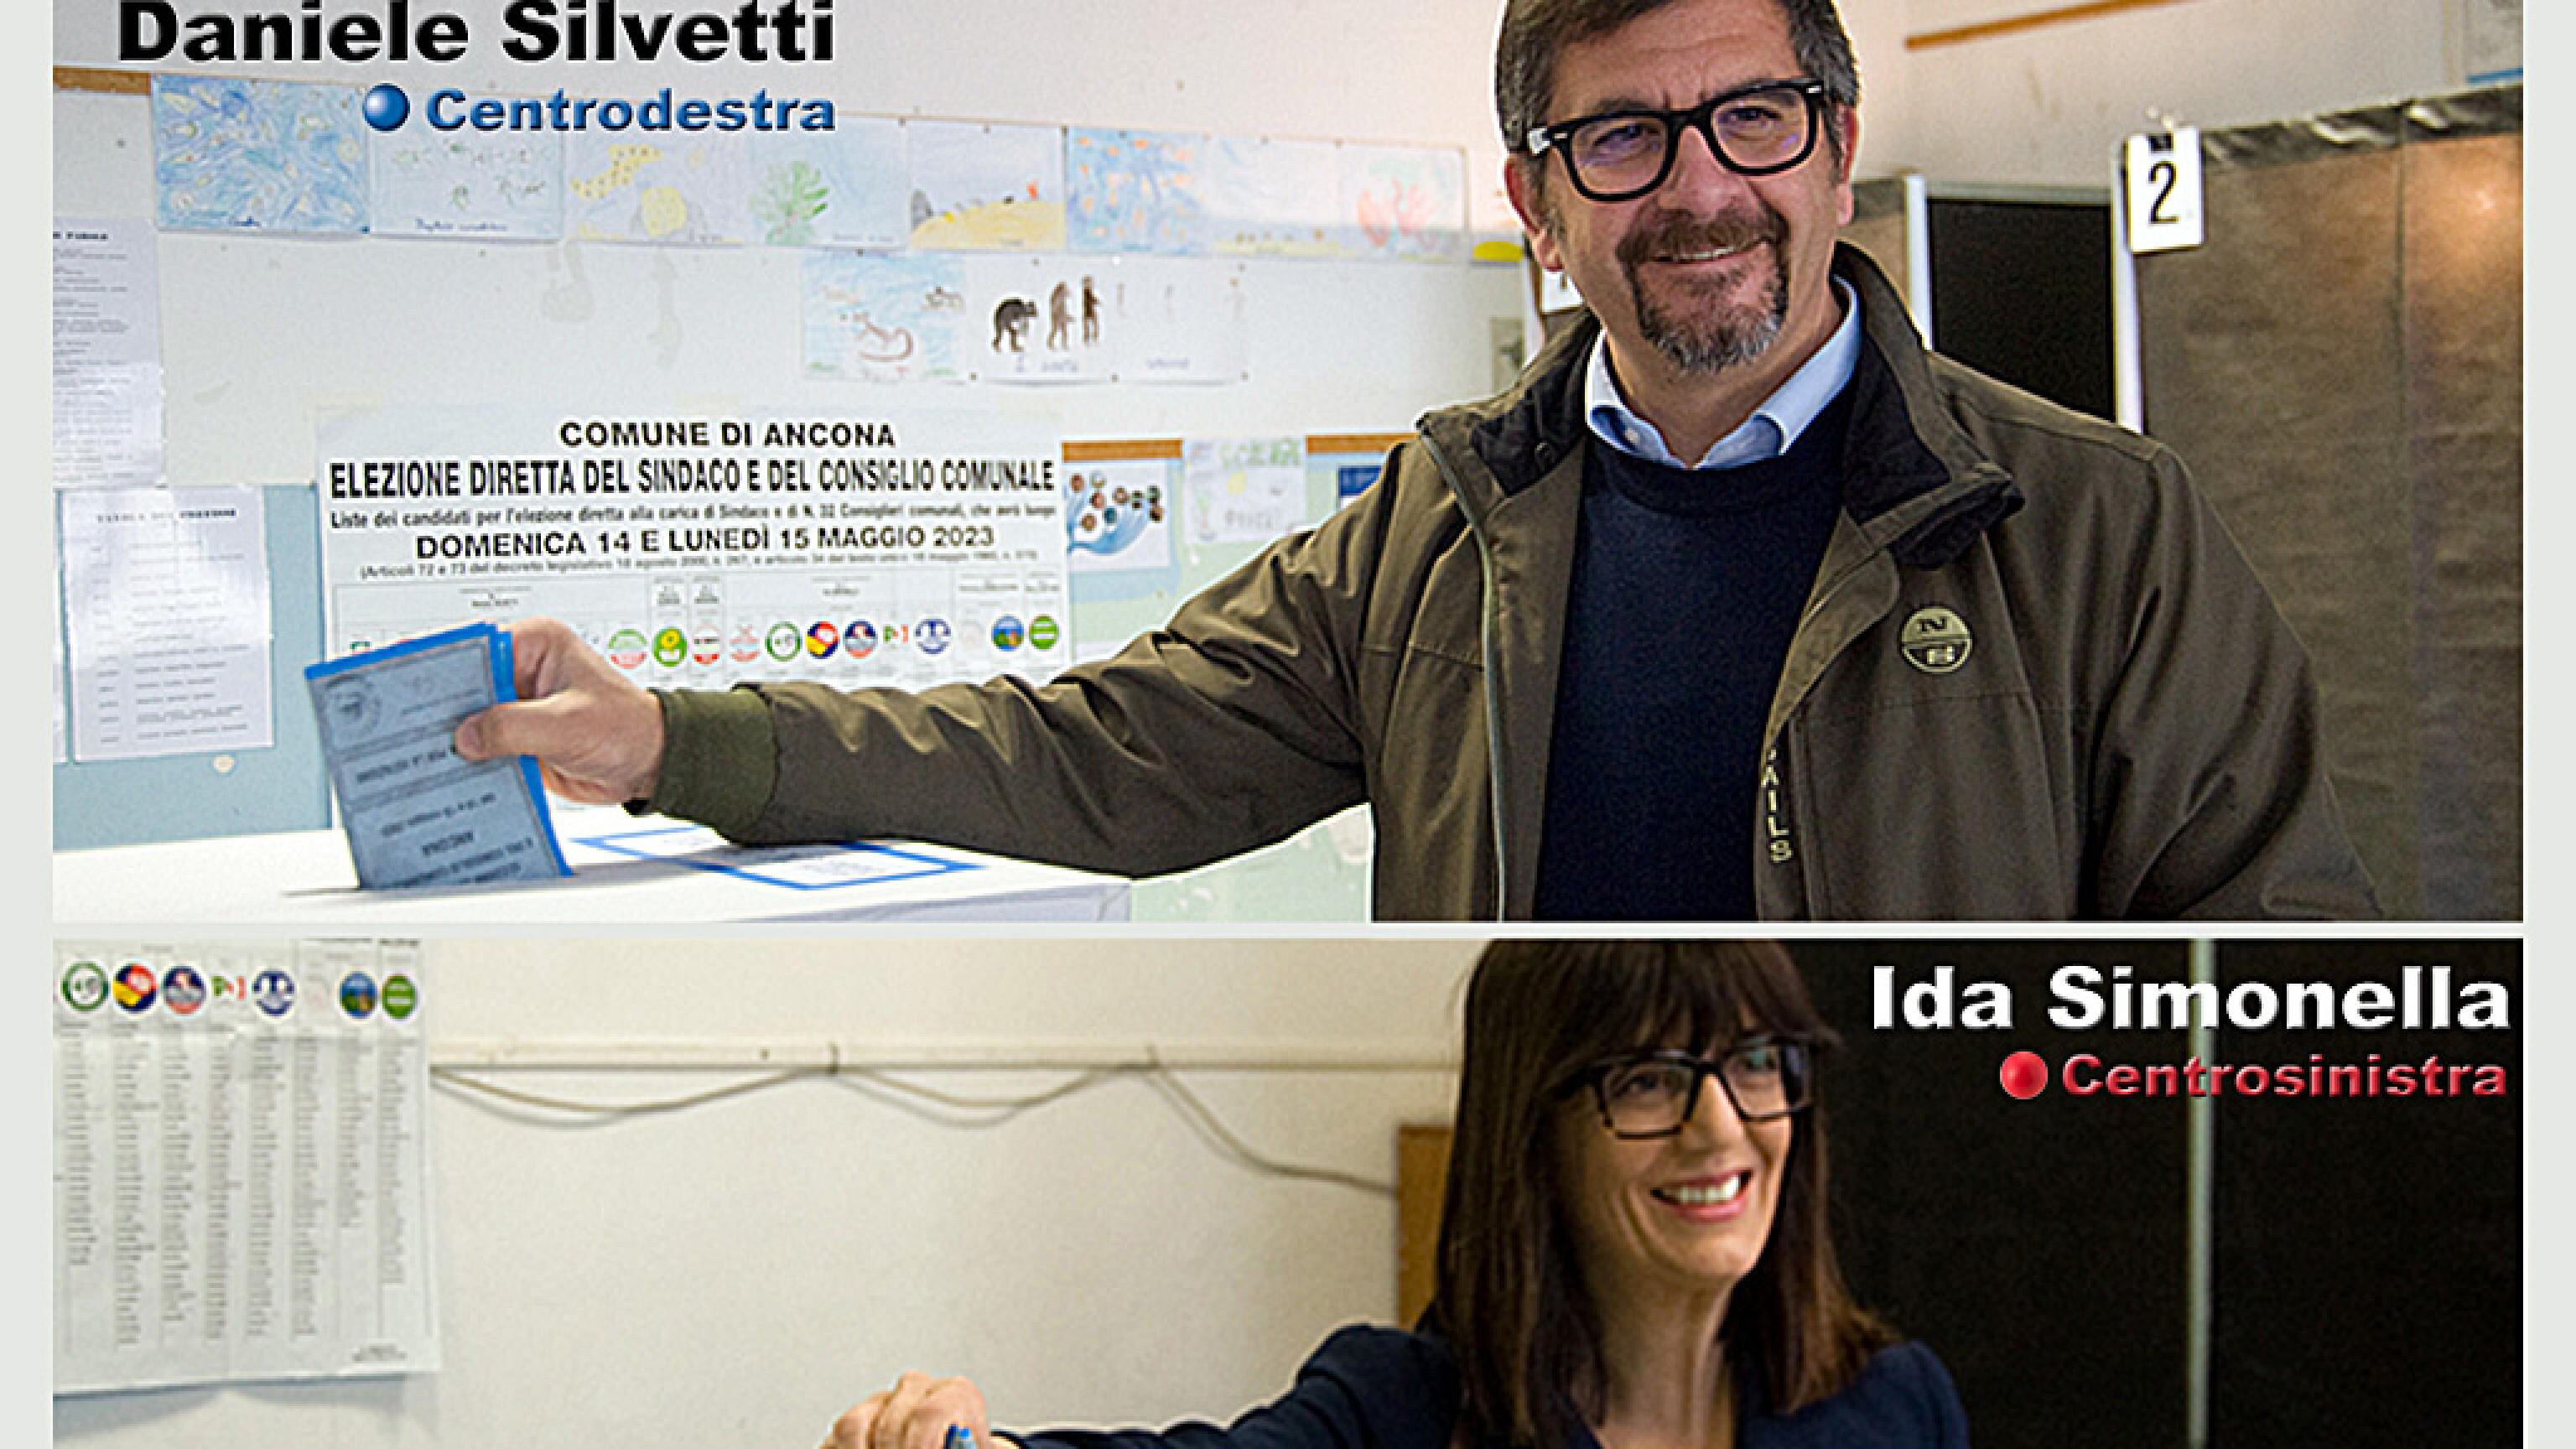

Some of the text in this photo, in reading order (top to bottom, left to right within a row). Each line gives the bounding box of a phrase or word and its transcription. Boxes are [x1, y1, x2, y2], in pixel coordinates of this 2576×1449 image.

[2147, 161, 2179, 225] 2
[560, 422, 896, 447] COMUNE DI ANCONA
[330, 458, 1055, 498] ELEZIONE DIRETTA DEL SINDACO E DEL CONSIGLIO COMUNALE
[331, 510, 368, 528] Liste
[374, 509, 398, 528] dei
[402, 508, 471, 527] candidati
[475, 510, 501, 527] per
[506, 506, 573, 525] l'elezione
[578, 506, 624, 522] diretta
[631, 506, 654, 522] alla
[658, 506, 699, 520] carica
[719, 504, 770, 519] Sindaco
[840, 503, 903, 520] Consiglieri
[416, 522, 995, 559] DOMENICA 14 E LUNEDÌ 15 MAGGIO 2023
[1762, 749, 1794, 863] AILS
